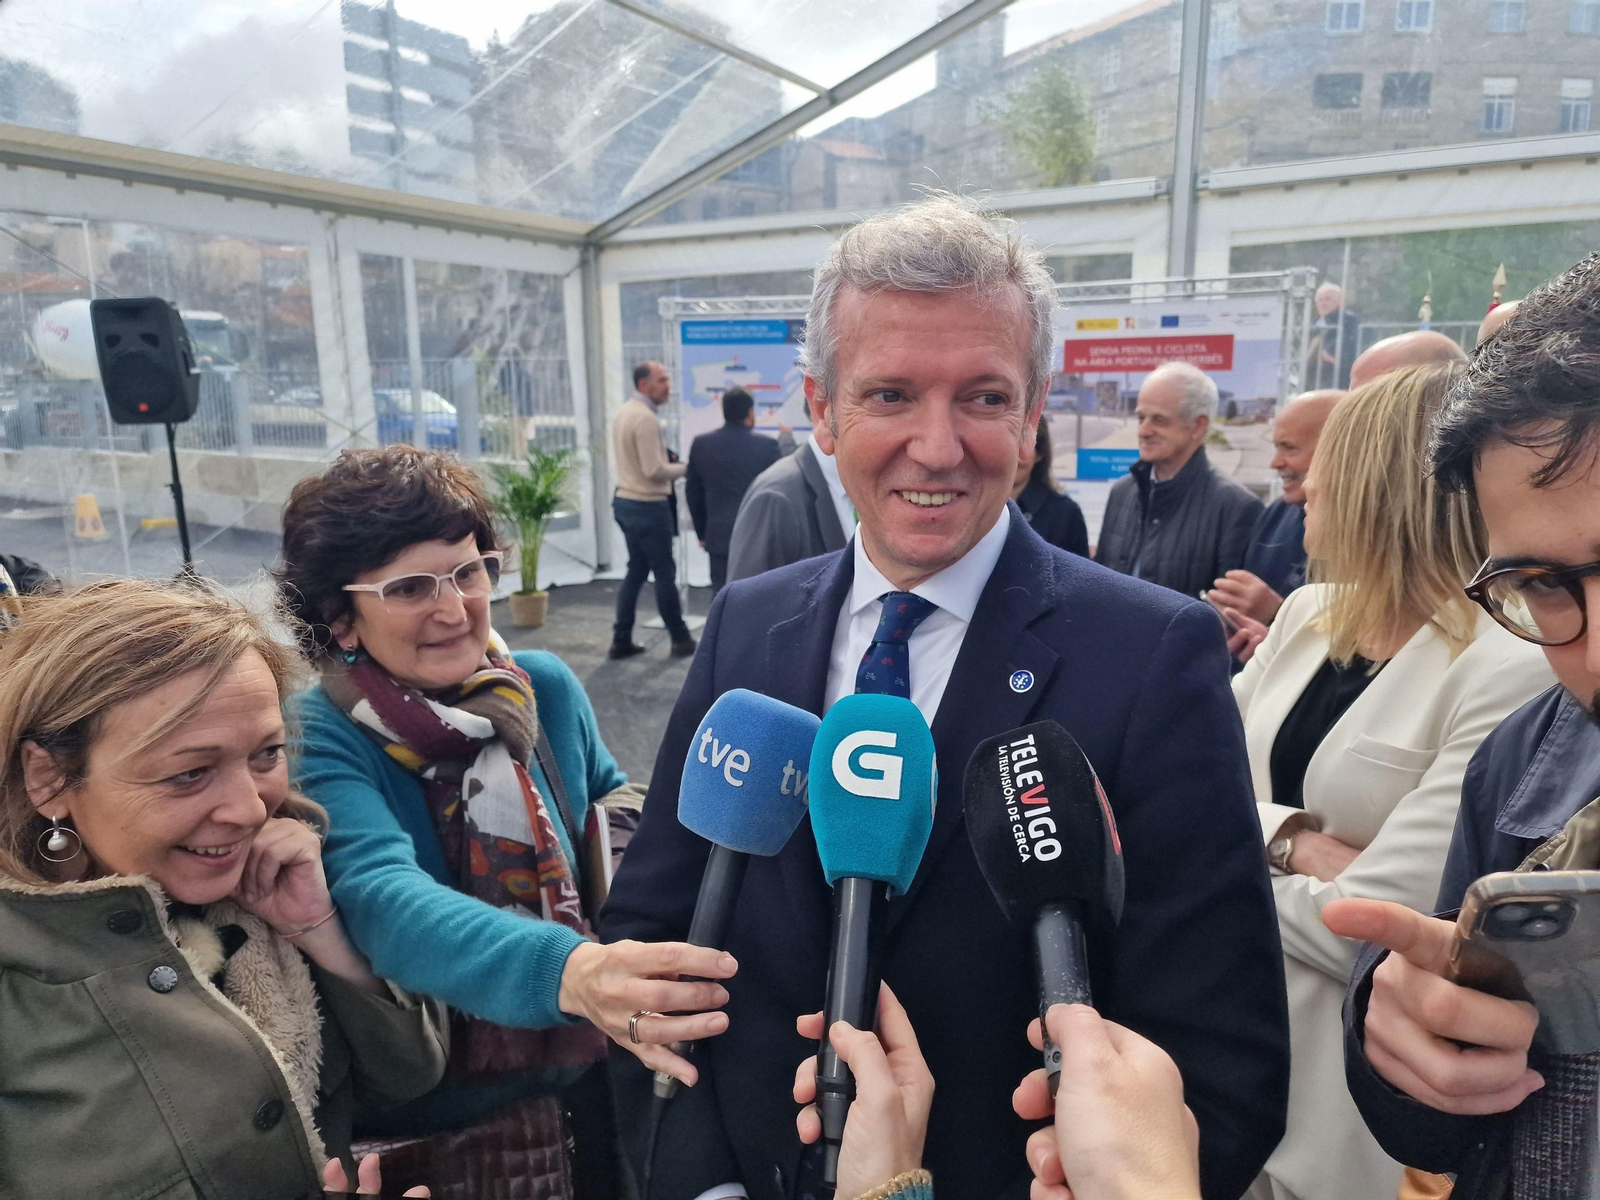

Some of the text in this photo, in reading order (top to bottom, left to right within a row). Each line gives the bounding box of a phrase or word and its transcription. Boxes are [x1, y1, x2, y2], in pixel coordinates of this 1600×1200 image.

[1074, 358, 1088, 366] NA
[1089, 356, 1113, 366] ÁREA
[1089, 346, 1119, 356] SENDA
[1121, 345, 1154, 355] PEONIL
[1164, 343, 1207, 353] CICLISTA
[698, 727, 751, 787] tve
[780, 759, 809, 805] tv
[831, 730, 904, 800] G
[998, 745, 1032, 863] LA TELEVISIÓN DE CERCA
[1010, 734, 1062, 862] TELEVIGO
